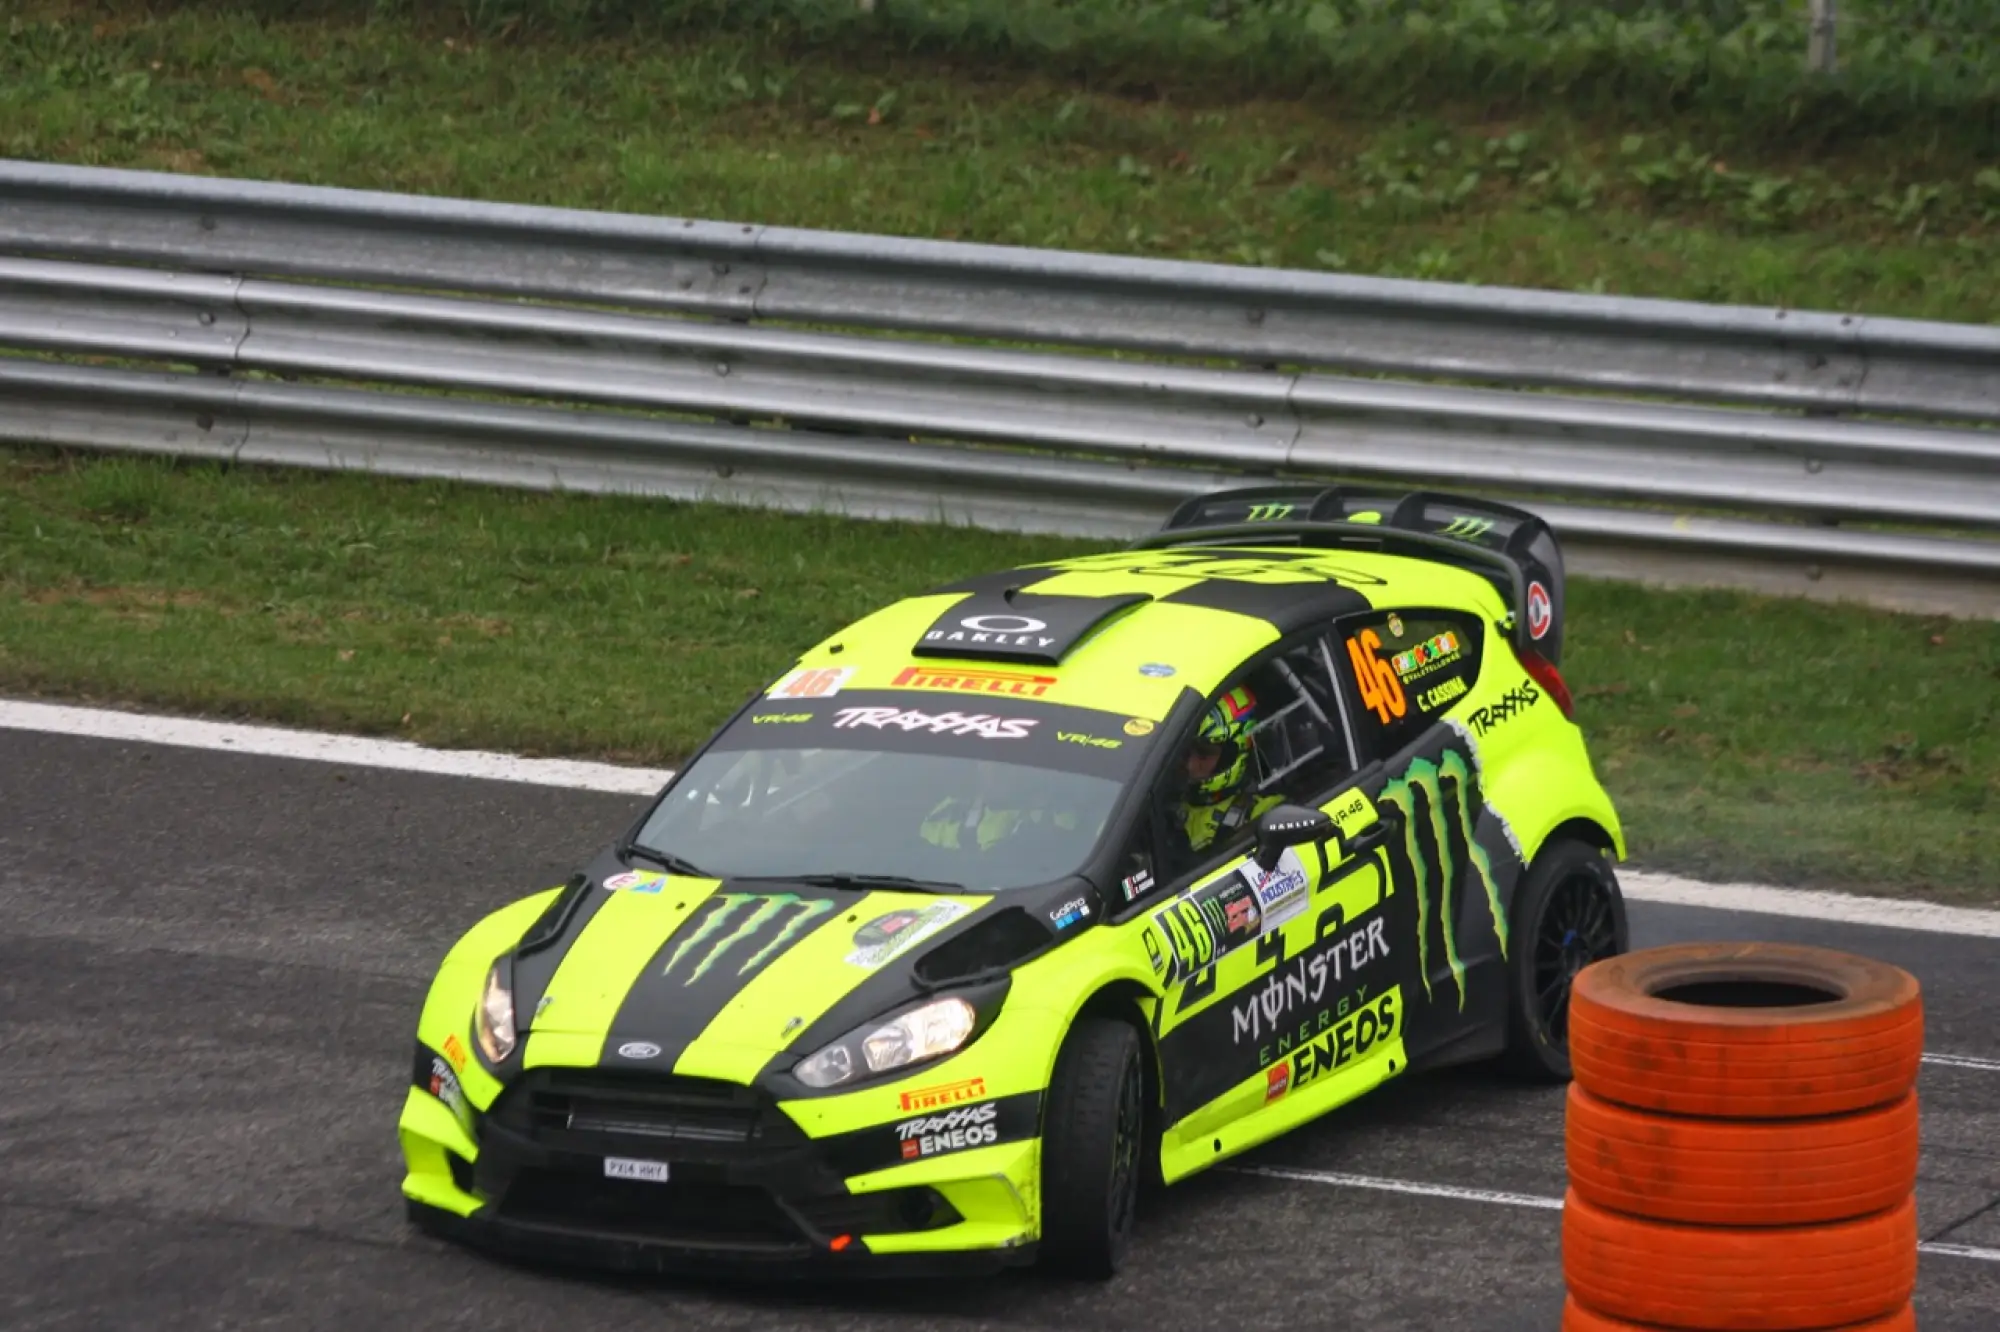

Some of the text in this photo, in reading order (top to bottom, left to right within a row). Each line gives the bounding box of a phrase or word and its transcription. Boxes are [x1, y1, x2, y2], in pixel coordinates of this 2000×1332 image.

[925, 630, 1055, 648] OAKLEY
[783, 669, 842, 697] 46
[890, 667, 1057, 696] PIRELLI
[1346, 628, 1407, 723] 46
[832, 706, 1039, 739] TRAXXAS
[1467, 679, 1540, 737] TRAXXAS
[1049, 897, 1086, 921] GoPro
[1164, 901, 1213, 973] 46
[1260, 984, 1368, 1066] ENERGY
[1291, 995, 1395, 1089] ENEOS
[901, 1077, 986, 1111] PIRELLI
[895, 1102, 998, 1141] TRAXXAS
[920, 1122, 998, 1155] ENEOS
